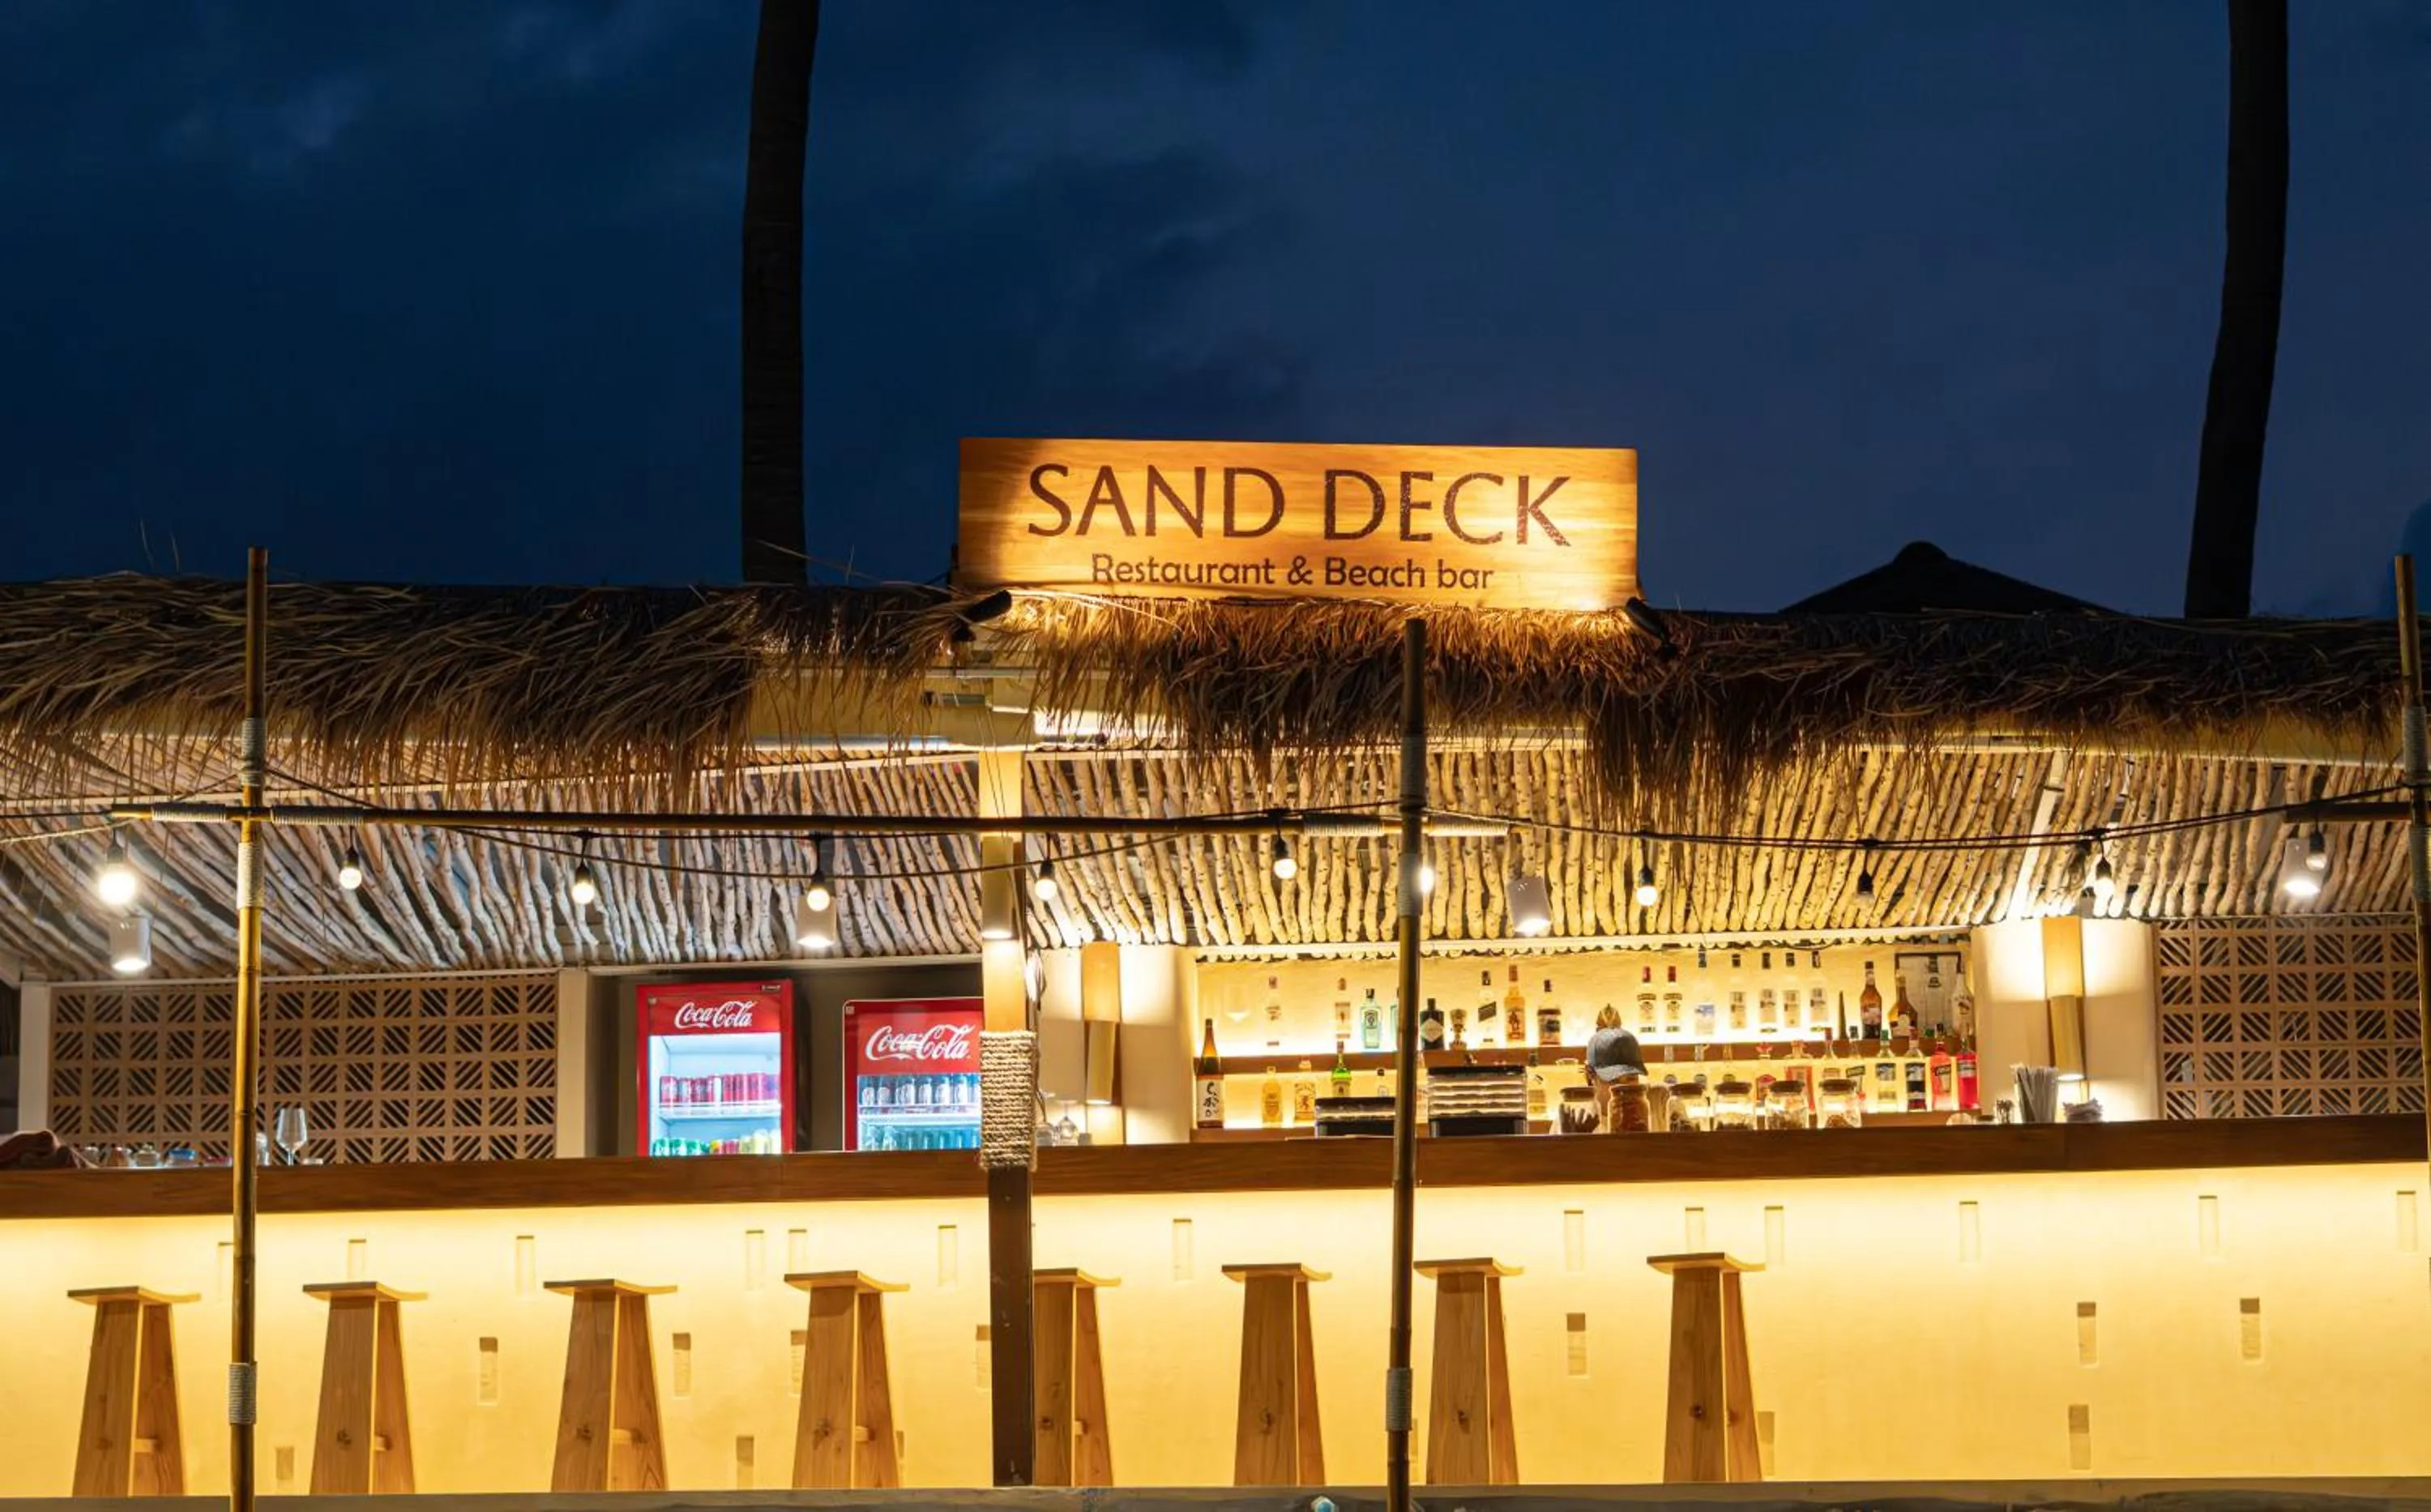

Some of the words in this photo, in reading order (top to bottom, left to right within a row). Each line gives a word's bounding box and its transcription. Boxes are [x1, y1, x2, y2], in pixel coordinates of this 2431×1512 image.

[1028, 463, 1285, 538] SAND
[1324, 469, 1571, 546] DECK
[1092, 553, 1275, 584] Restaurant
[1287, 555, 1313, 585] &
[1325, 557, 1426, 587] Beach
[1438, 559, 1495, 589] bar
